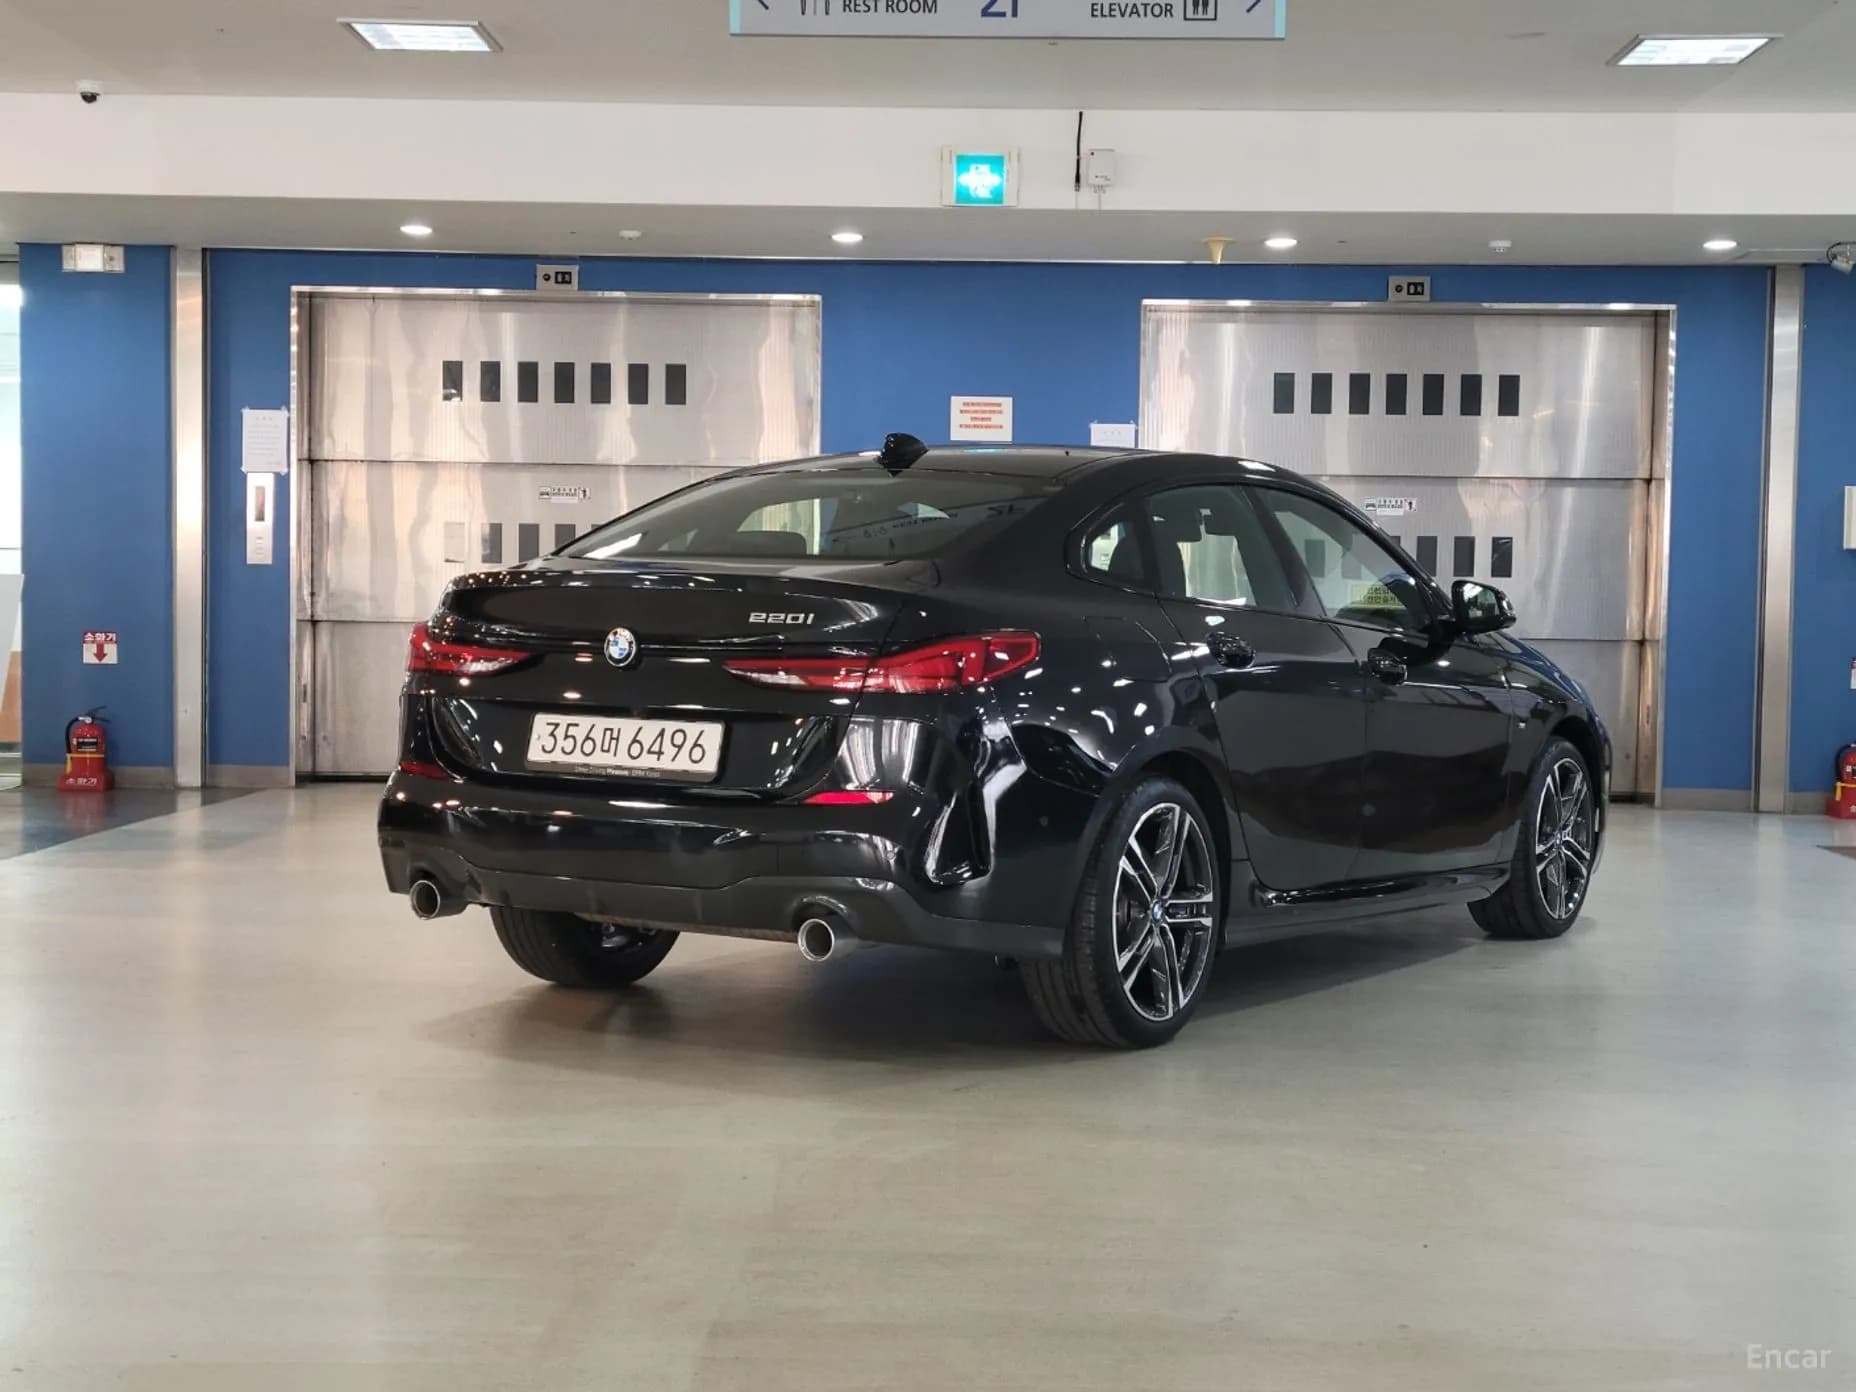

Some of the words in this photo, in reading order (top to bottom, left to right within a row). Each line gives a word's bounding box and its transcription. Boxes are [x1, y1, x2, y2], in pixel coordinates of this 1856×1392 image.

[842, 0, 880, 13] REST
[885, 0, 938, 14] ROOM
[1090, 2, 1174, 19] ELEVATOR
[84, 632, 116, 642] 소화기
[627, 726, 706, 764] 6496
